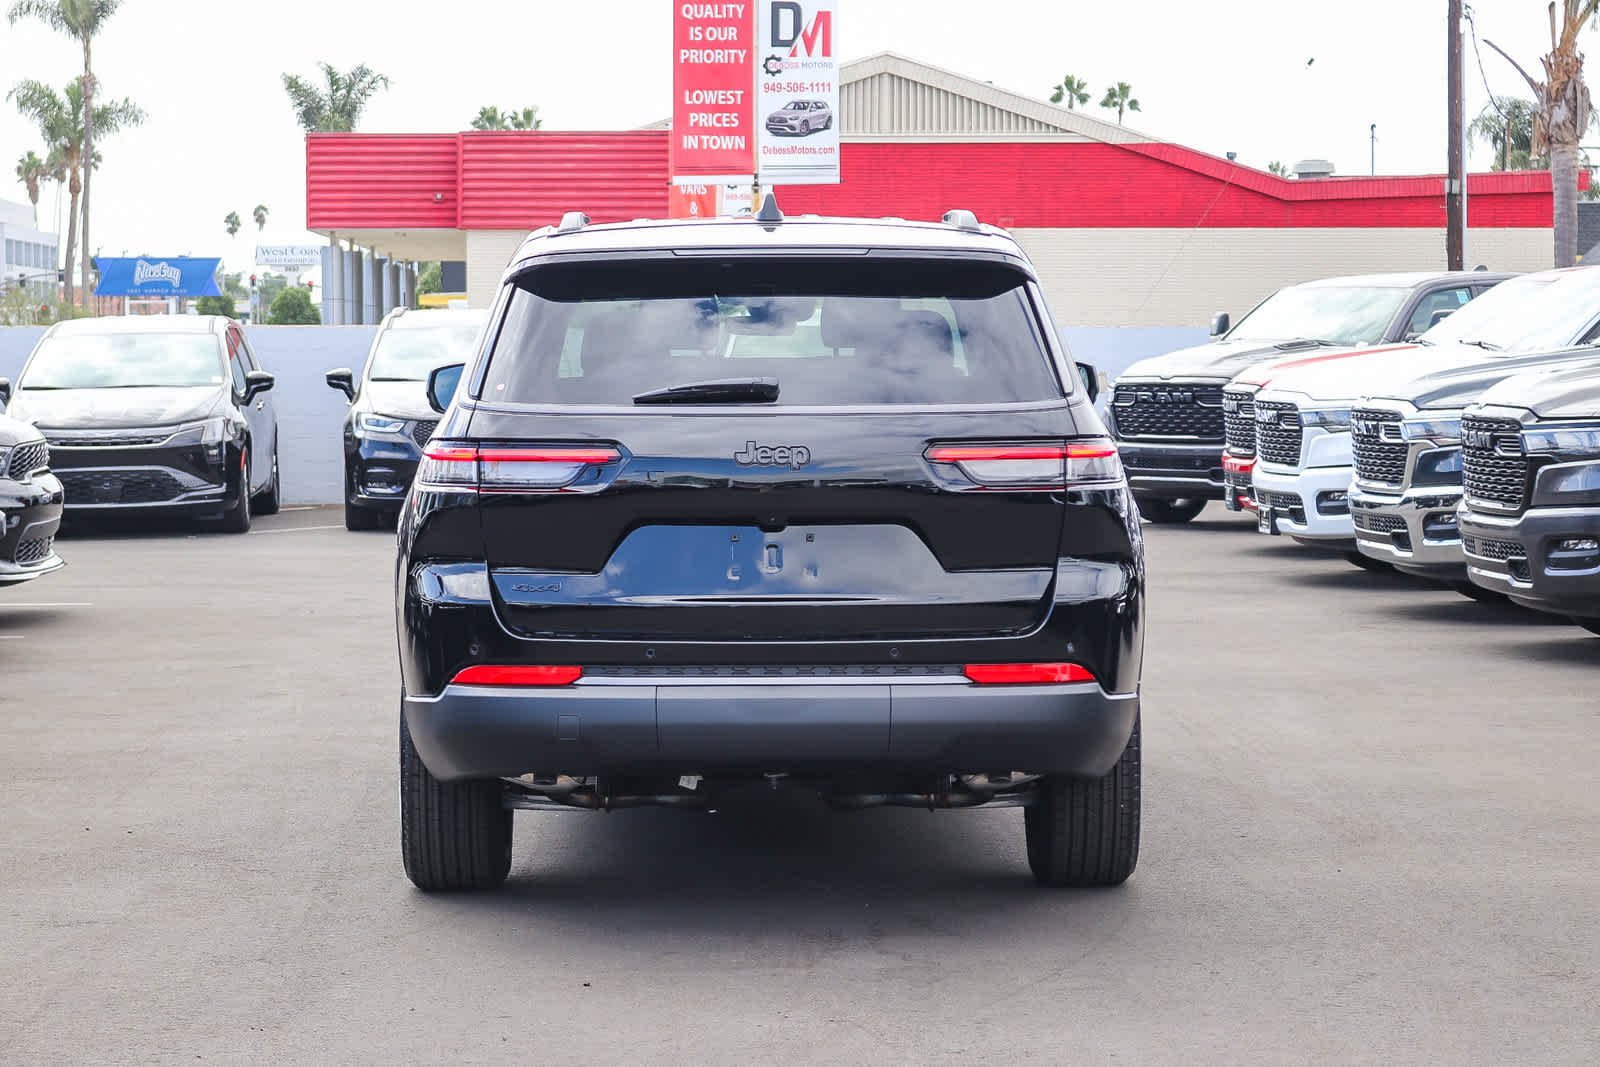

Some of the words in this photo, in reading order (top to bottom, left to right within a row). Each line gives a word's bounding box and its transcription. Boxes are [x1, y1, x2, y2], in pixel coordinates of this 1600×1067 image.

[682, 4, 745, 19] QUALITY
[689, 27, 702, 41] IS
[706, 27, 738, 41] OUR
[680, 49, 747, 64] PRIORITY
[763, 82, 832, 94] 949-506-1111
[685, 90, 744, 105] LOWEST
[689, 113, 739, 128] PRICES
[683, 135, 698, 150] IN
[701, 135, 746, 150] TOWN
[261, 247, 288, 256] West
[1136, 391, 1194, 403] RAM
[734, 440, 811, 471] Jeep
[512, 583, 562, 593] 4x4
